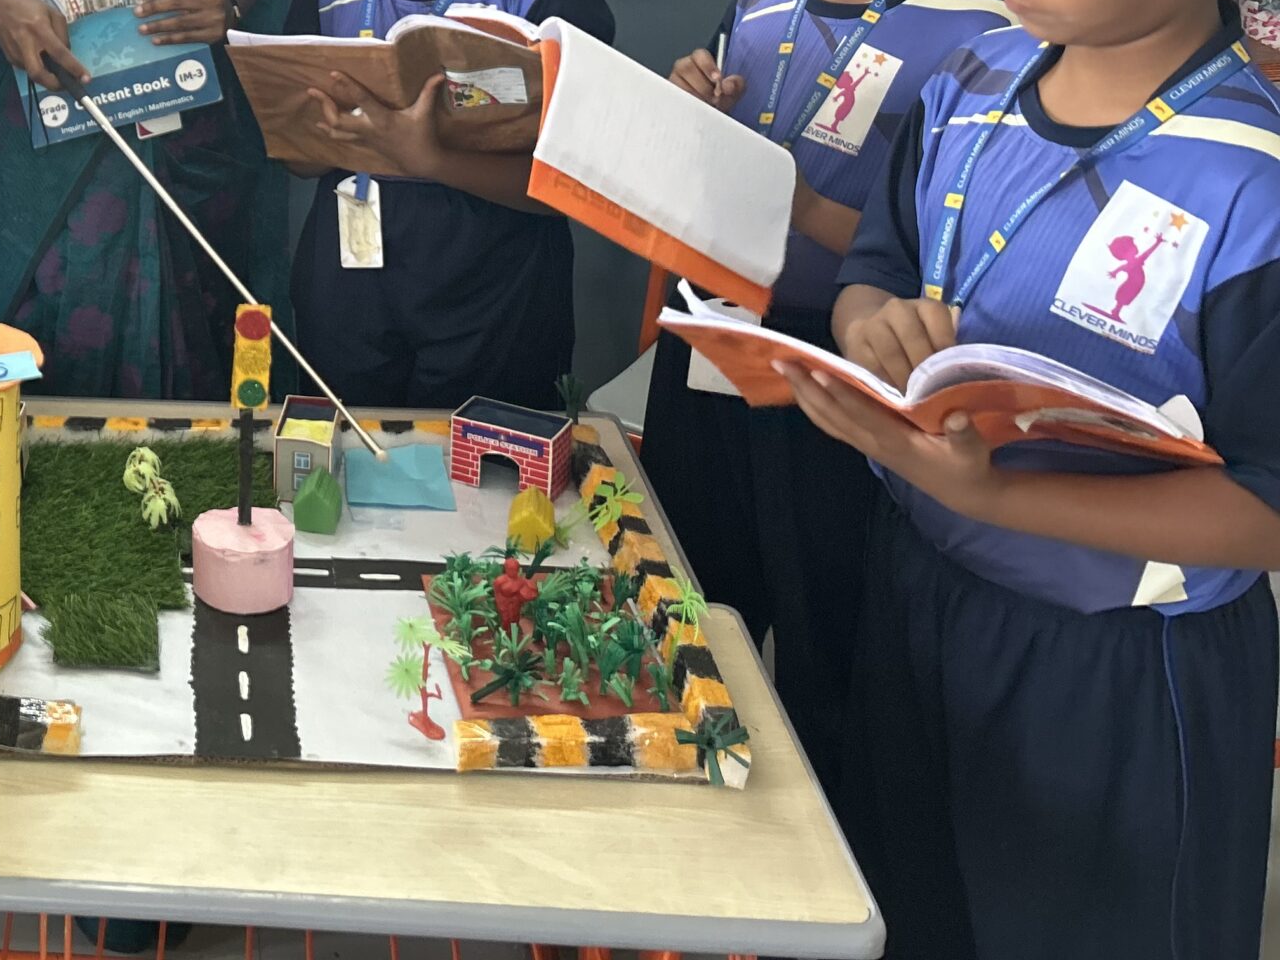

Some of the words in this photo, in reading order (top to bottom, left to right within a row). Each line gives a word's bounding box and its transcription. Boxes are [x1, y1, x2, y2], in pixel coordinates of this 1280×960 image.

[831, 46, 850, 71] CLEVER
[846, 25, 865, 48] MINDS
[133, 77, 170, 95] Book
[179, 68, 204, 83] IM-3
[767, 83, 780, 109] CLEVER
[775, 59, 786, 84] MINDS
[1170, 72, 1204, 100] CLEVER
[1203, 55, 1232, 78] MINDS
[61, 120, 86, 135] Inquiry
[118, 107, 144, 121] English
[148, 94, 194, 112] Mathematics
[1115, 116, 1145, 141] MINDS
[828, 135, 860, 153] MINDS
[957, 157, 975, 189] CLEVER
[971, 130, 989, 160] MINDS
[933, 246, 947, 279] CLEVER
[941, 216, 955, 247] MINDS
[1052, 297, 1108, 330] CLEVER
[1108, 324, 1159, 350] MINDS
[466, 432, 500, 447] POLICE
[500, 441, 538, 457] STATION
